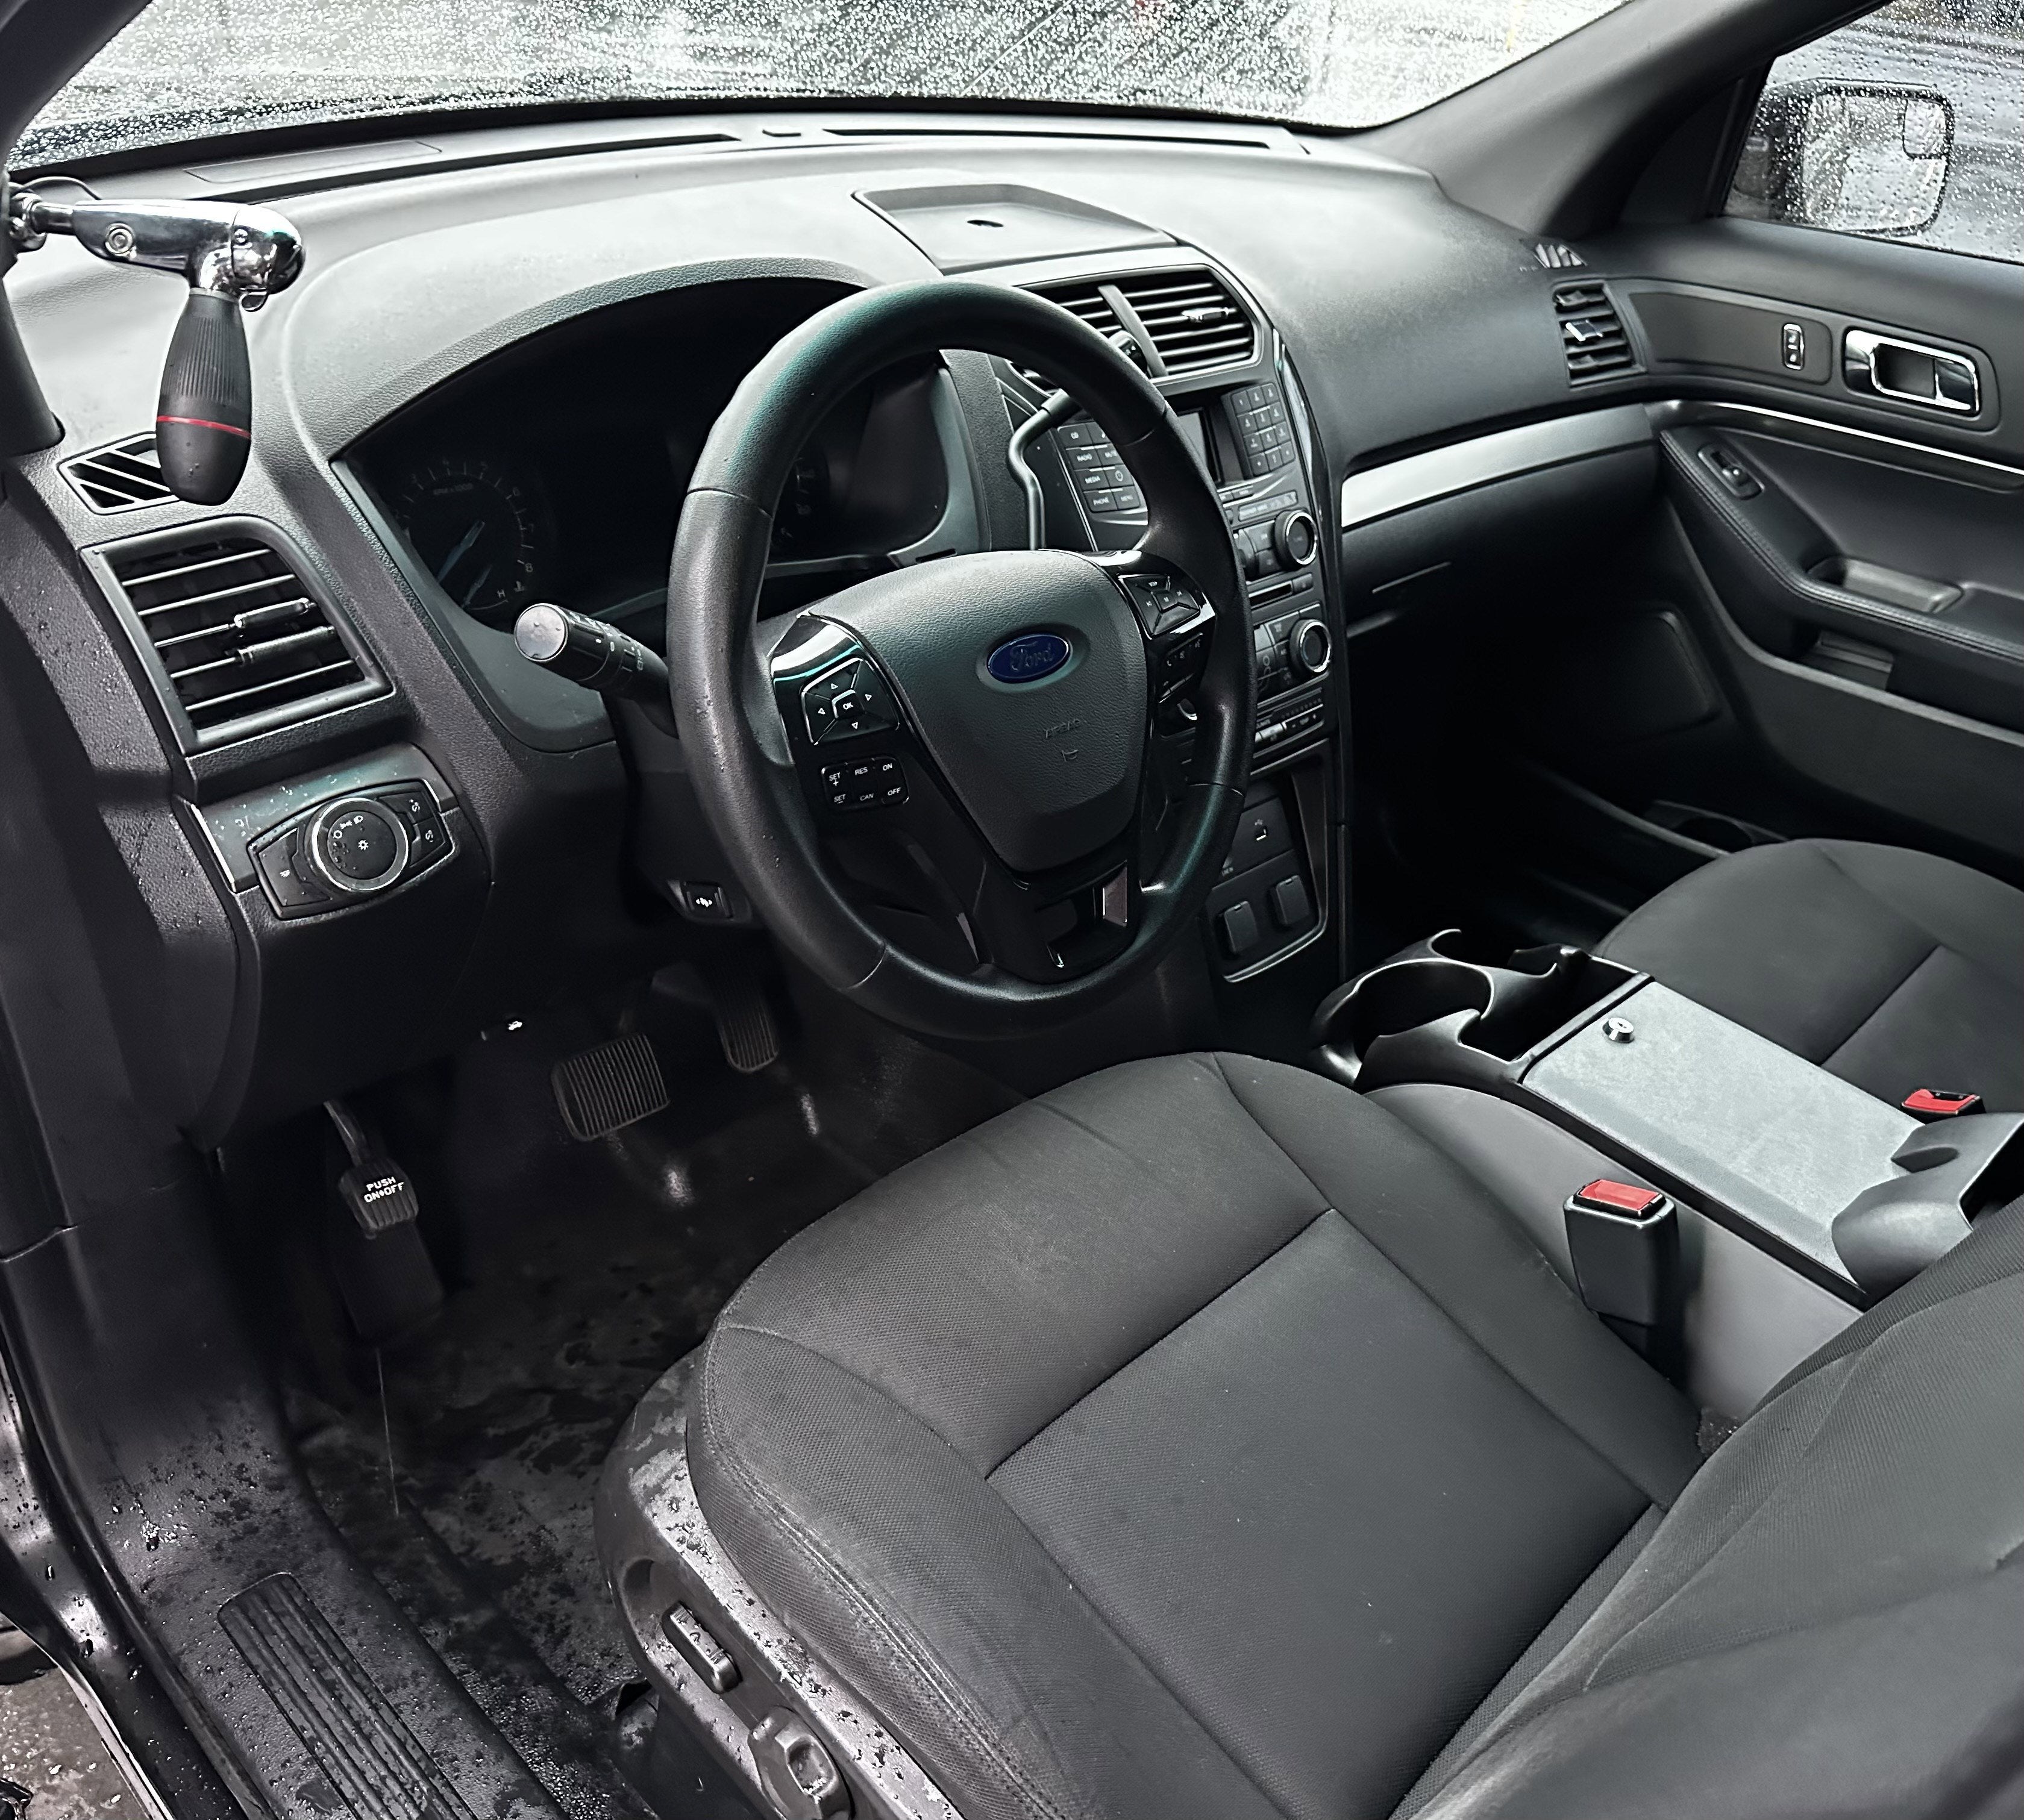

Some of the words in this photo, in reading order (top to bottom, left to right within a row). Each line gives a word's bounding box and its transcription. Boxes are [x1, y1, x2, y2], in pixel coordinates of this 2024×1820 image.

[1085, 475, 1101, 484] MEDIA
[1092, 496, 1109, 506] PHONE
[497, 589, 506, 599] H
[1009, 641, 1054, 672] Ford
[842, 701, 854, 710] OK
[854, 766, 868, 776] RES
[882, 762, 893, 771] ON
[829, 772, 841, 781] SET
[887, 787, 902, 796] OFF
[833, 793, 847, 803] SET
[859, 792, 874, 801] CAN
[366, 1176, 396, 1192] PUSH
